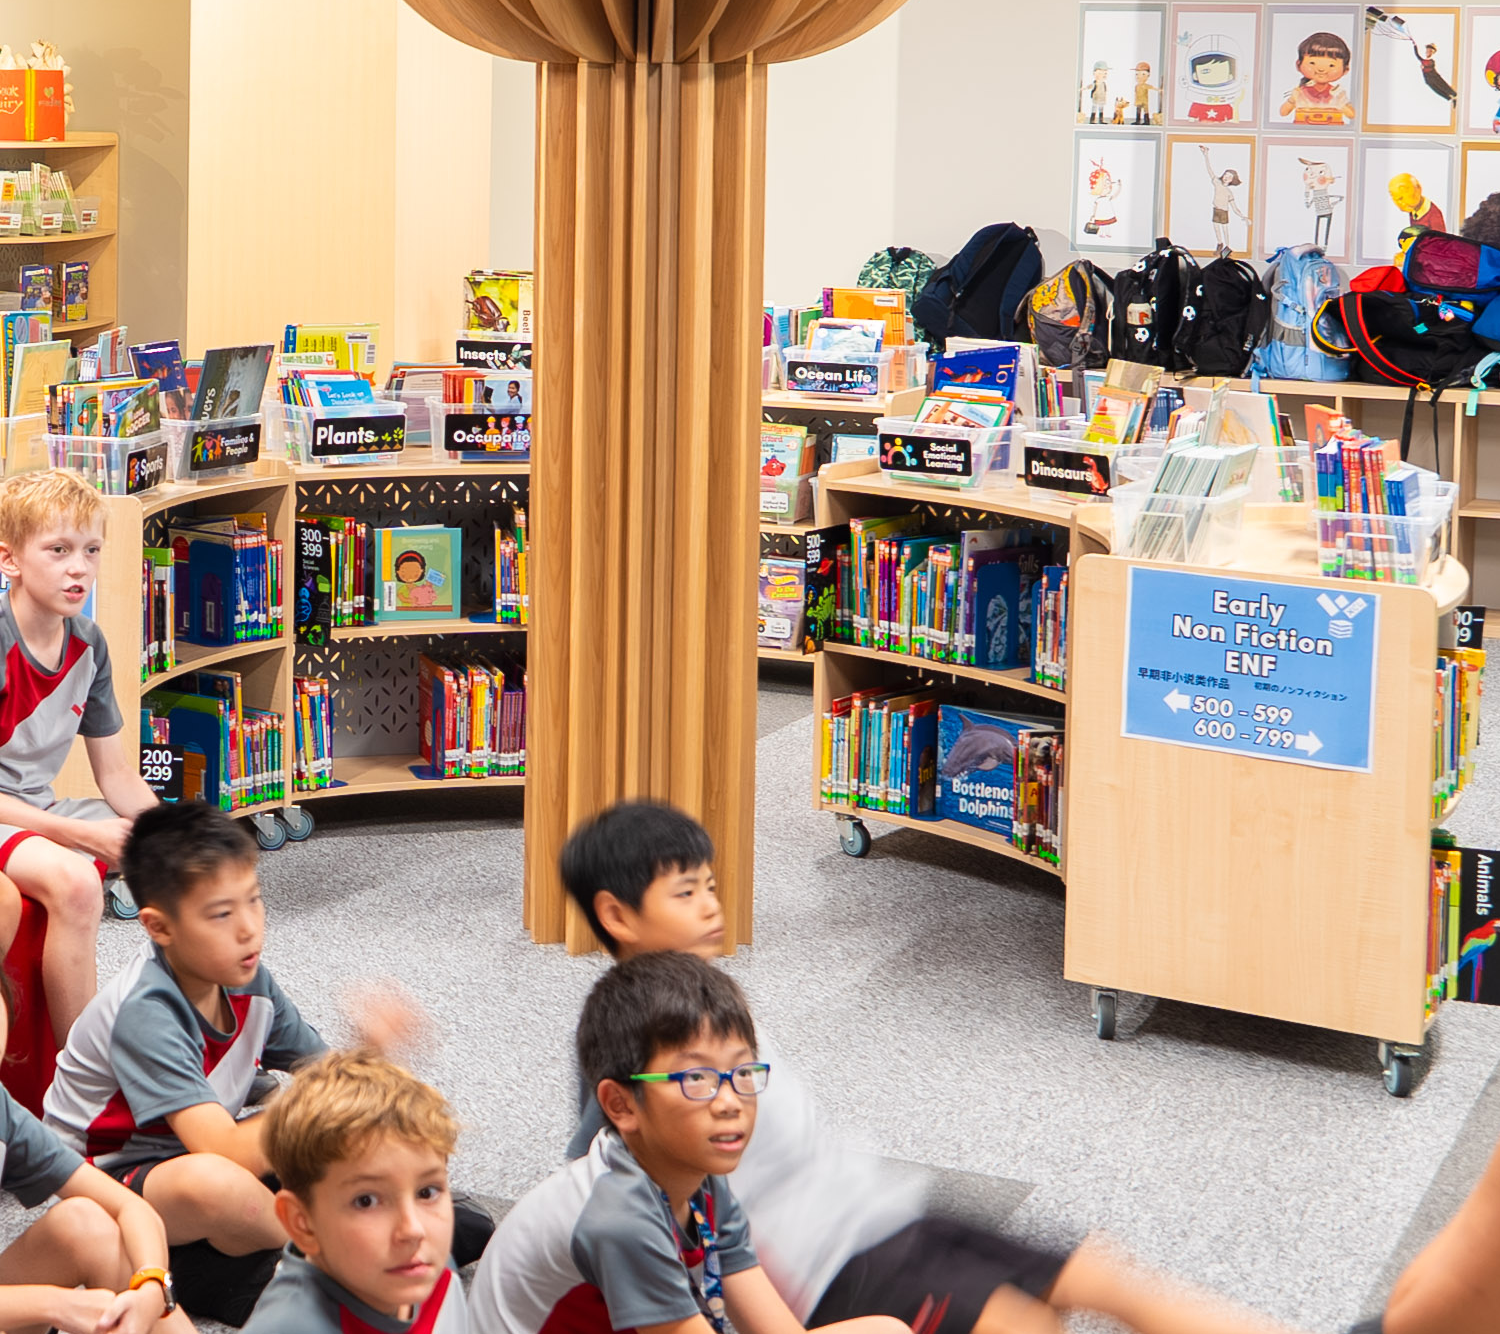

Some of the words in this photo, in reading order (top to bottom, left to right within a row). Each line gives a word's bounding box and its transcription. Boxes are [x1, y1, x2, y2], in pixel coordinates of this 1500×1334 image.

[460, 347, 507, 361] Insects
[795, 367, 842, 382] Ocean
[845, 369, 872, 383] Life
[220, 436, 248, 448] Families
[317, 425, 375, 446] Plants
[453, 430, 530, 449] Occupatio
[225, 444, 249, 457] People
[923, 450, 965, 462] Emotional
[930, 442, 957, 453] Social
[140, 454, 164, 476] Sports
[925, 459, 963, 472] Learning
[1031, 459, 1093, 482] Dinosaurs
[301, 542, 323, 558] 399
[806, 549, 821, 564] 599
[1213, 590, 1287, 627] Early
[1172, 614, 1226, 643] Non
[1234, 622, 1334, 657] Fiction
[1224, 650, 1277, 678] ENF
[1138, 667, 1230, 690] 早期非小说类作品
[1254, 681, 1348, 702] 初期のノンフィクション
[1192, 695, 1234, 718] 500
[1252, 703, 1293, 726] 599
[1193, 718, 1236, 741] 600
[1253, 726, 1295, 749] 799
[142, 766, 173, 782] 299
[958, 797, 1014, 819] Dolphins
[1476, 853, 1489, 916] Animals
